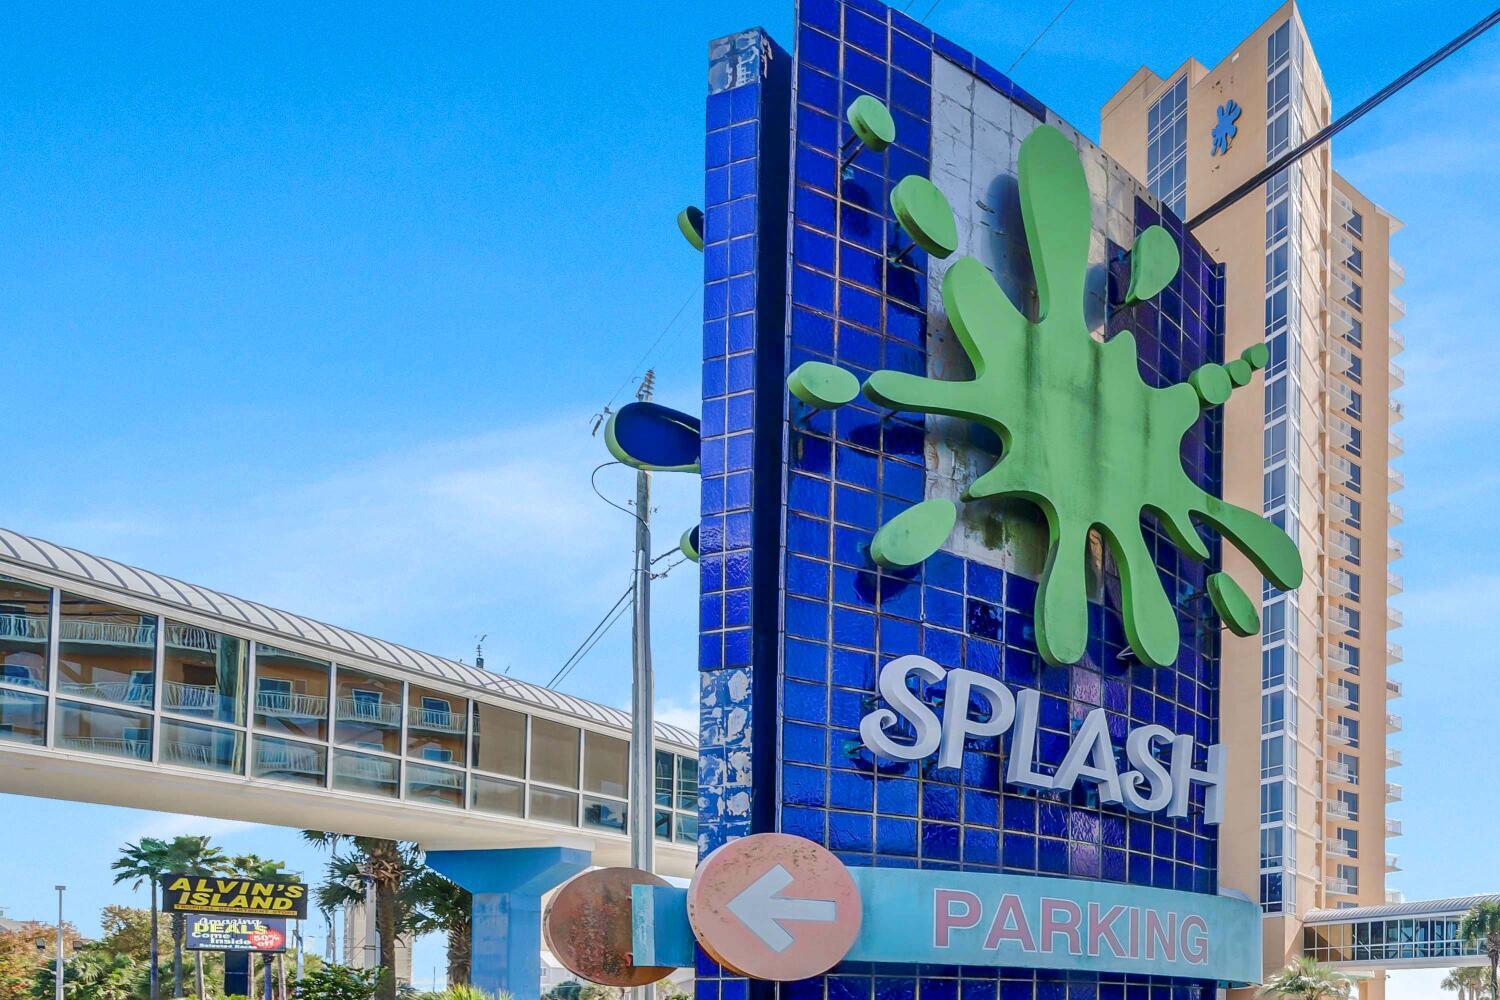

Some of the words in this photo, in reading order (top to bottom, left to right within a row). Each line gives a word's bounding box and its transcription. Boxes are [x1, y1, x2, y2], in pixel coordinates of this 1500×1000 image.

[859, 654, 1228, 825] SPLASH
[168, 877, 305, 899] ALVIN'S
[178, 891, 294, 910] ISLAND
[194, 922, 268, 935] DEALS
[933, 887, 1209, 966] PARKING
